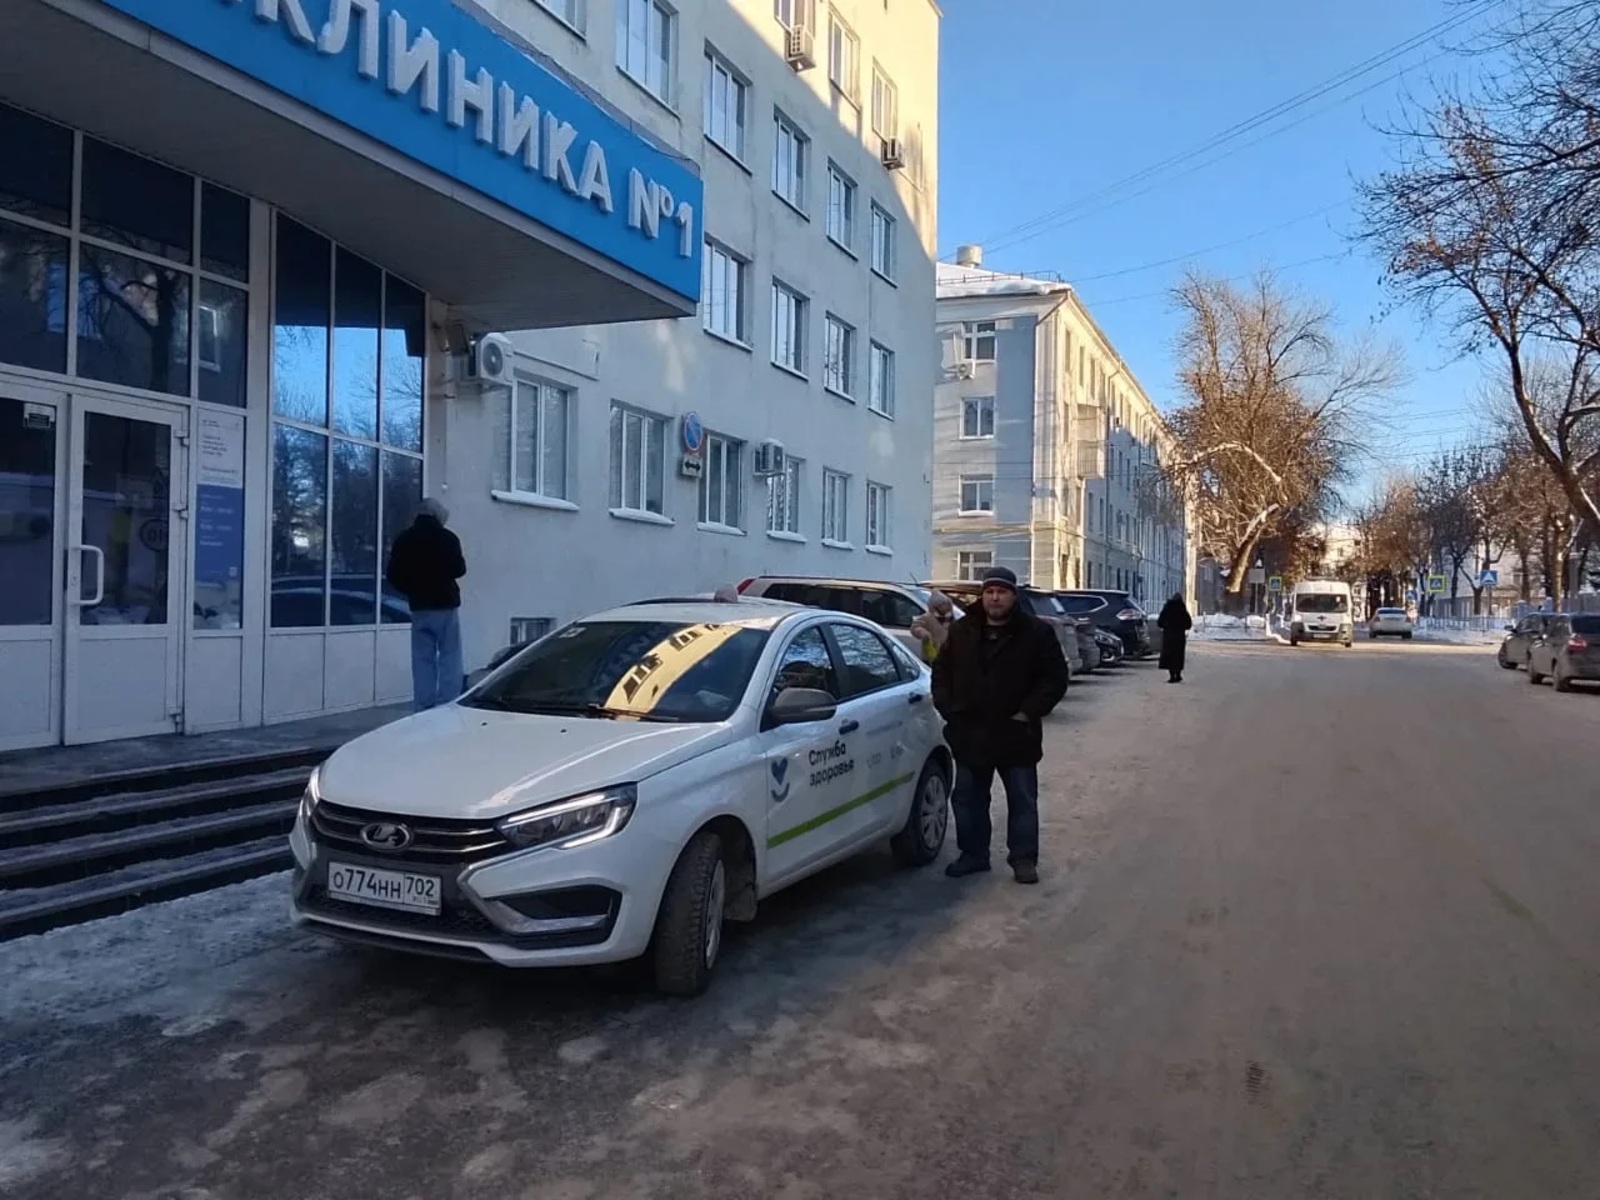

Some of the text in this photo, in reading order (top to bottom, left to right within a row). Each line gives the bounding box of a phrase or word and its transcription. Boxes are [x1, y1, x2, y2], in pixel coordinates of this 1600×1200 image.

[218, 0, 614, 212] ЛИНИКА
[808, 740, 847, 768] Служба
[809, 759, 855, 787] здоровья
[405, 876, 435, 897] 702
